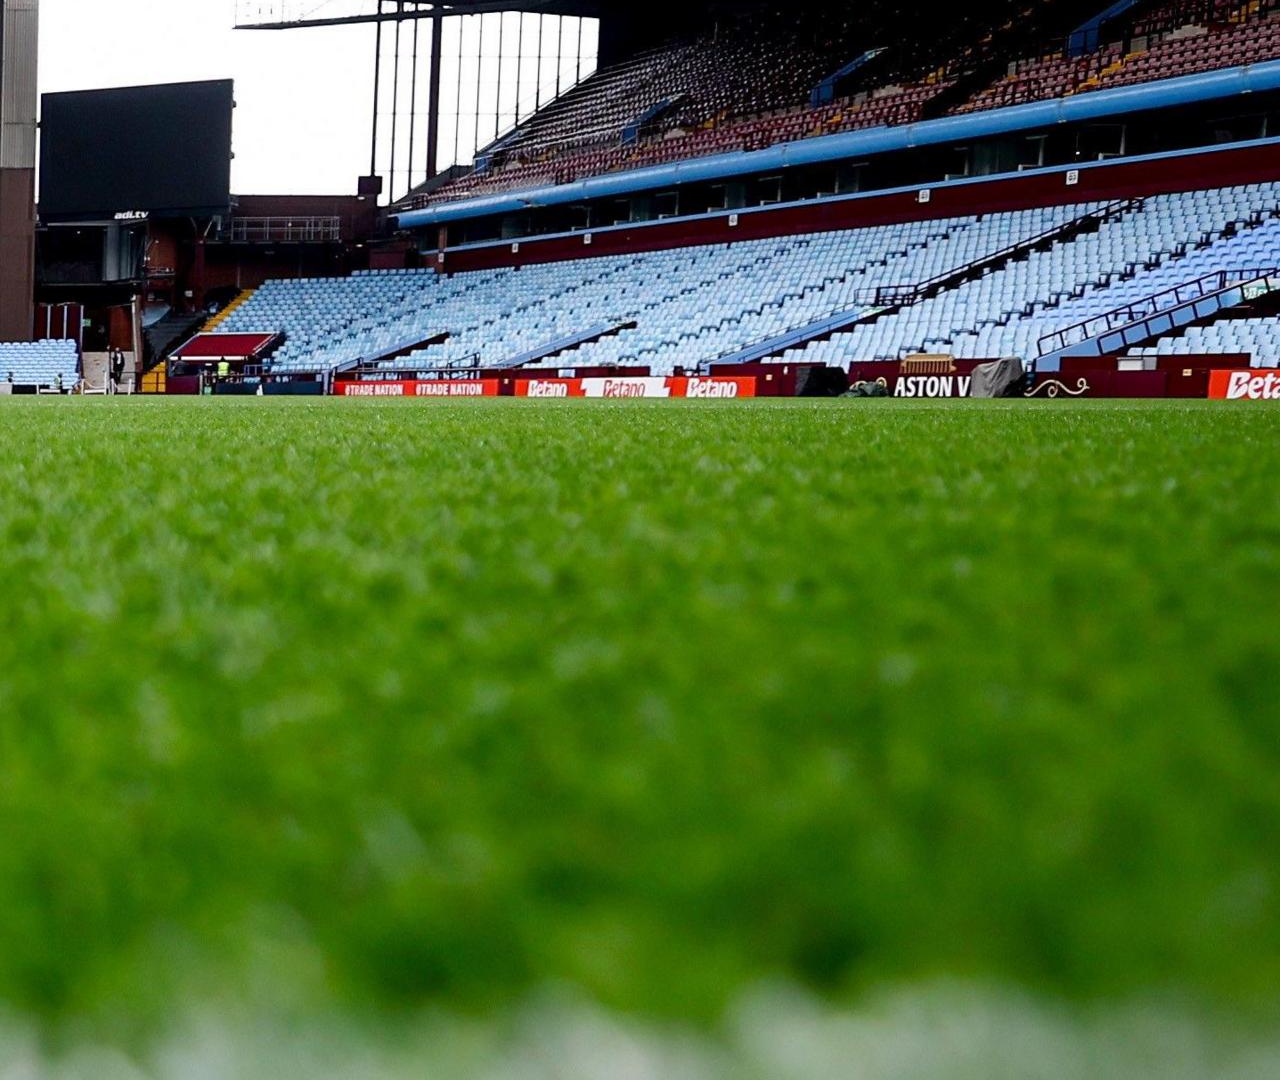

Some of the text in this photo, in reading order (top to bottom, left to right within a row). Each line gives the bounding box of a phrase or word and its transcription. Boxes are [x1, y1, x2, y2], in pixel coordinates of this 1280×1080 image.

[351, 384, 404, 396] TRADE NATION
[421, 383, 483, 396] TRADE NATION
[527, 380, 568, 398] Betano
[603, 378, 646, 398] Betano
[686, 378, 738, 398] Betano
[894, 376, 953, 397] ASTON
